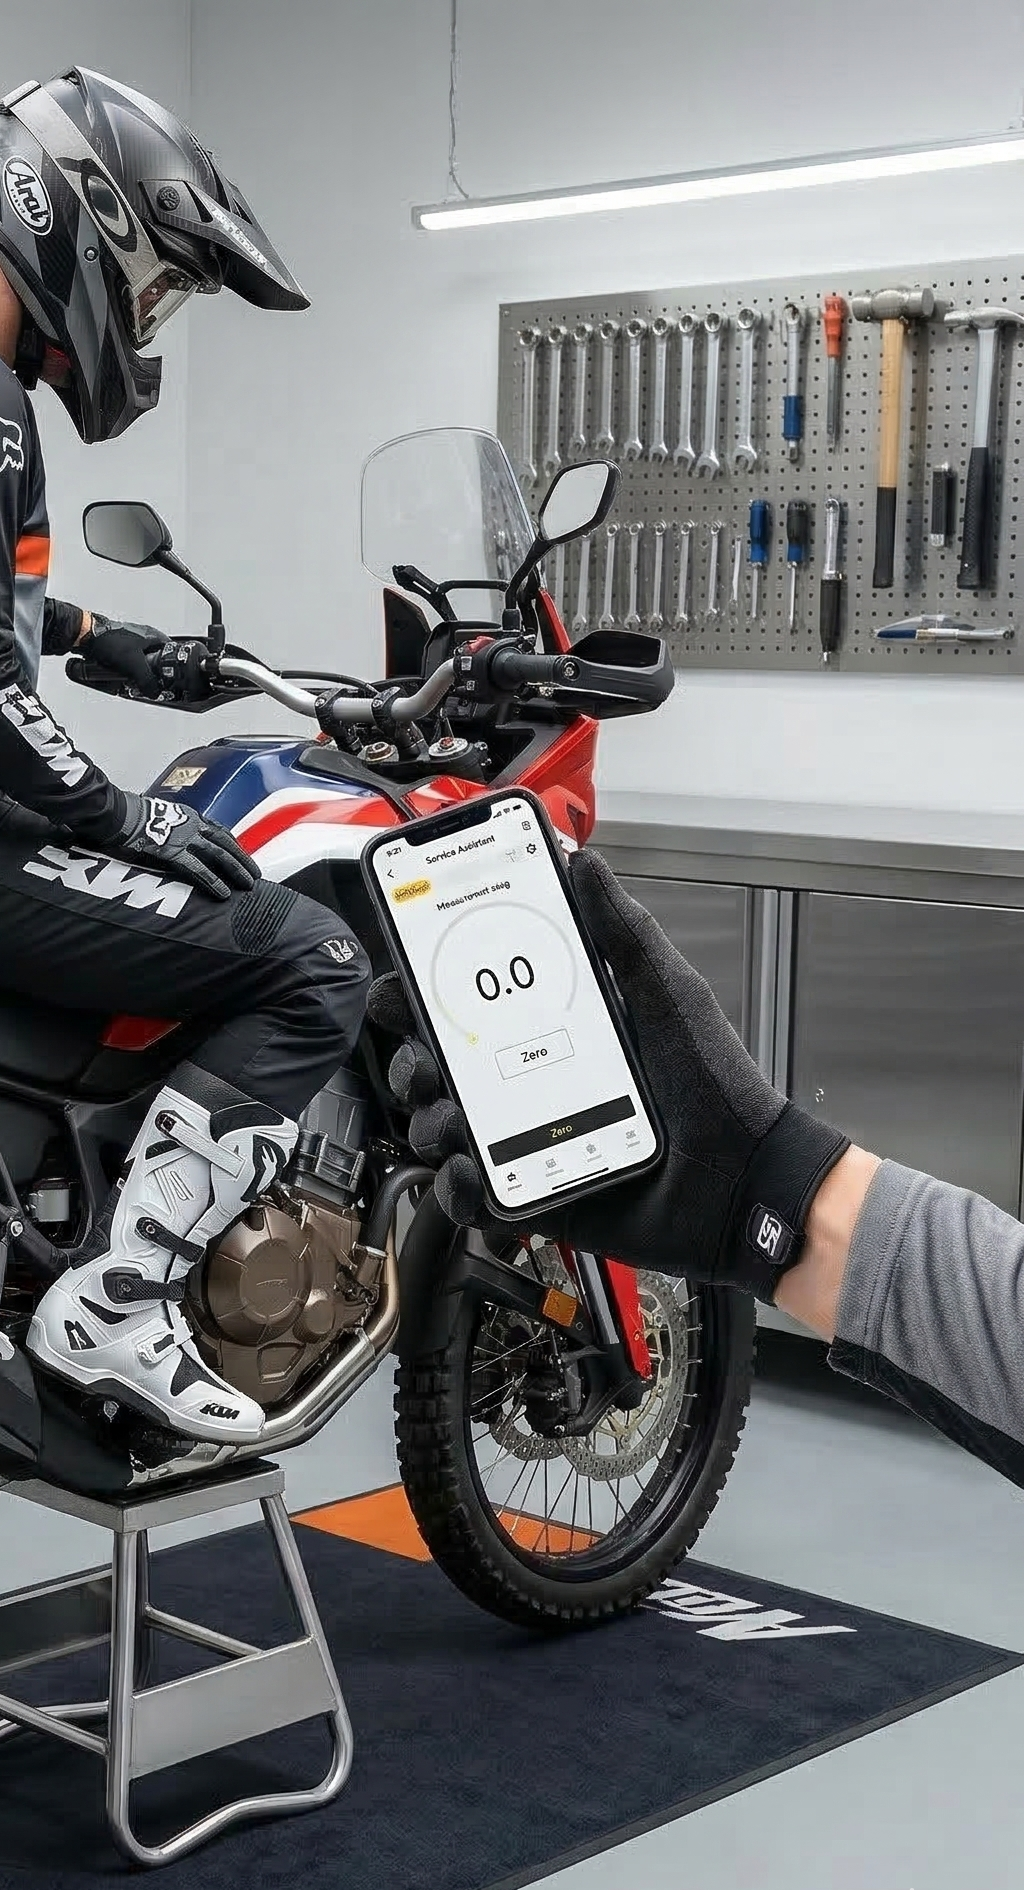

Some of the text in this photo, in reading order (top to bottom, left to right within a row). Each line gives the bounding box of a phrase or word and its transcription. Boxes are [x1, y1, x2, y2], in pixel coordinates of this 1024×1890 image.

[6, 159, 49, 222] Arai
[475, 955, 536, 1001] 0.0
[520, 1045, 549, 1064] Zero
[550, 1125, 573, 1138] Zero
